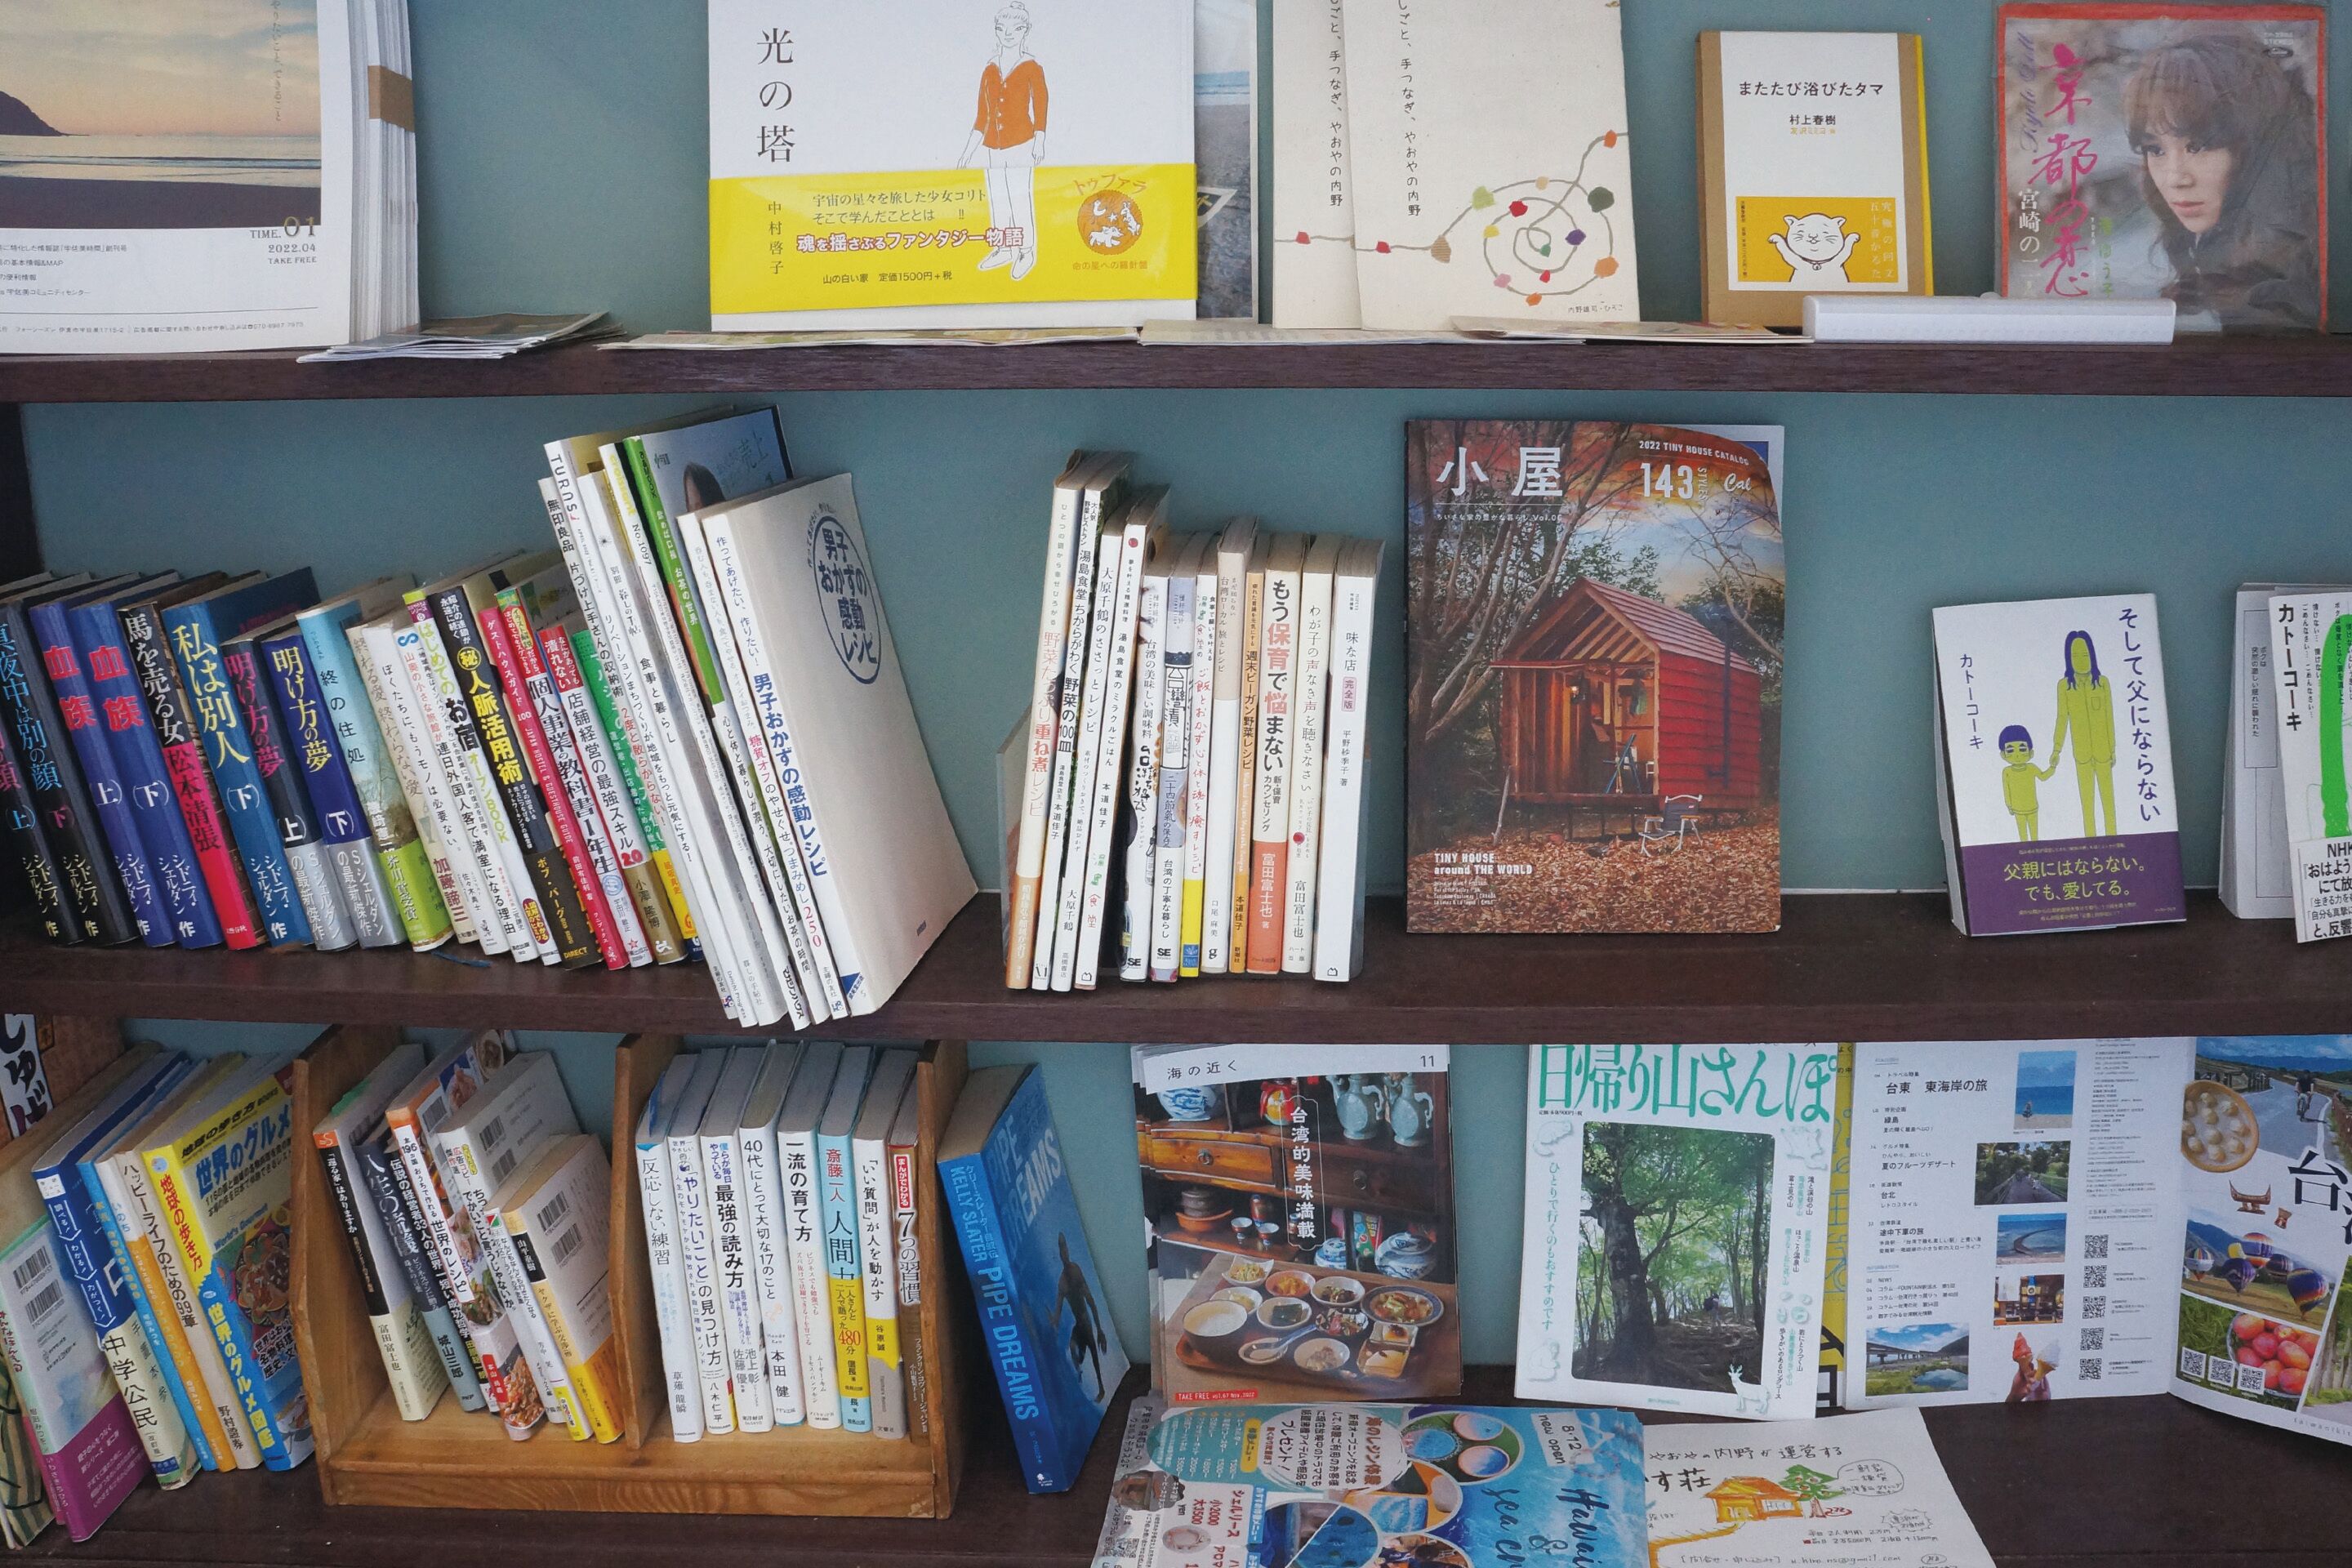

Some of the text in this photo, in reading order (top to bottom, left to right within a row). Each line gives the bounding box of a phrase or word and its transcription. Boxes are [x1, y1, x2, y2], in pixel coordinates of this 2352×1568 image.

[756, 27, 795, 163] 光の塔
[1739, 81, 1884, 97] またたび浴びたタマ
[1788, 114, 1837, 126] 村上春樹
[2028, 42, 2099, 297] 京都の恋
[813, 188, 986, 206] 宇宙の星々を旅した少女コリト
[813, 208, 935, 225] そこで学んだこととは
[268, 243, 315, 253] 2022.04
[284, 216, 315, 237] 01
[768, 200, 783, 275] 中村啓子
[796, 227, 1024, 253] 魂を揺さぶるファンタジー物語
[268, 256, 317, 265] TAKE FREE
[822, 272, 869, 284] 山の白い家
[1436, 446, 1563, 497] 小屋
[1639, 440, 1750, 466] 2022 TINY HOUSE CATALOG
[1640, 462, 1708, 501] 143 STYLES
[1080, 500, 1091, 546] 野菜レストラン
[1089, 502, 1098, 522] 大人気
[631, 523, 653, 565] No.1097
[546, 499, 575, 552] 無印良品
[569, 561, 626, 698] 片づけ上手さんの収納術
[487, 620, 532, 722] ゲストハウスガイド 100
[545, 640, 570, 689] 潰れない
[559, 636, 580, 685] なにがあっても
[1057, 550, 1092, 753] 湯島食堂 ちからがわく 野菜の100皿
[1085, 567, 1114, 733] 大原千鶴のささっとレシピ
[1263, 578, 1291, 772] もう保育で悩まない
[1343, 631, 1359, 710] 味な店 完全版
[2278, 603, 2302, 732] カトーコーキ
[42, 645, 97, 732] 血族
[88, 645, 145, 733] 血族
[124, 612, 185, 746] 馬を売る女
[172, 621, 251, 770] 私は別人
[639, 657, 677, 744] 食事と暮らし
[1104, 632, 1127, 767] 湯島食堂のミラクルごはん
[1141, 639, 1158, 739] 台湾の美味しい調味料
[1299, 605, 1321, 792] わが子の声なき声を聴きなさい
[1959, 653, 1984, 751] カトーコーキ
[225, 652, 286, 778] 明け方の夢
[274, 645, 333, 773] 明け方の夢
[319, 670, 366, 765] 終の住処
[469, 670, 523, 786] 人脈活用術
[1241, 650, 1258, 770] 週末ビーガン野菜レシピ
[2118, 608, 2161, 822] そして父にならない
[378, 706, 423, 798] 終わらない愛
[382, 664, 461, 852] ぼくたちに、もうモノは必要ない。
[567, 693, 635, 849] 店舗経営の最強スキル
[753, 672, 827, 877] 男子おかずの感動レシピ
[167, 748, 222, 853] 松本清張
[468, 752, 510, 844] オープンBOOK
[747, 733, 793, 845] 糖質オフのやせぐせ。
[1098, 782, 1111, 828] 本道佳子
[1261, 776, 1272, 832] カウンセリング
[1272, 775, 1281, 804] 新・保育
[559, 823, 573, 844] GUIDE
[1434, 853, 1494, 863] TINY HOUSE
[337, 851, 372, 938] の最新傑作
[433, 857, 469, 923] 加藤諦三
[1259, 853, 1276, 918] 富田富士也
[1434, 865, 1533, 875] around THE WORLD
[2003, 856, 2145, 881] 父親にはならない。
[2025, 880, 2130, 902] でも、愛してる。
[1063, 889, 1078, 931] 大原千鶴
[1160, 859, 1174, 938] 台湾の丁寧な暮らし
[1234, 895, 1245, 931] 本道佳子
[1293, 880, 1307, 938] 富田富士也
[45, 920, 59, 938] 作
[84, 920, 99, 938] 作
[136, 920, 150, 937] 作
[178, 920, 196, 938] 作
[270, 922, 287, 939] 作
[563, 947, 587, 960] DIRECT
[1157, 947, 1172, 957] SE
[1127, 957, 1141, 967] SE
[782, 966, 805, 1020] マガジンハウス
[1167, 1055, 1436, 1080] 海の近く 11
[1538, 1044, 1838, 1124] 日帰り山さんぽ
[1886, 1078, 1988, 1094] 台東 東海岸の旅
[195, 1104, 292, 1199] 世界のグルメ
[709, 1143, 722, 1180] やっている
[719, 1143, 733, 1184] 僕らが毎日
[826, 1147, 846, 1203] 斎藤一人
[1290, 1106, 1317, 1240] 台湾的美味満載
[1881, 1160, 1957, 1170] 夏のフルーツデザート
[641, 1156, 670, 1266] 反応しない練習
[786, 1142, 813, 1243] 一流の育て方
[950, 1165, 973, 1209] KELLY
[1881, 1191, 1896, 1200] 台北
[160, 1174, 203, 1270] 地球の歩き方
[414, 1169, 469, 1294] おうちで作れる 世界のレシピ
[715, 1183, 745, 1289] 最強の読み方
[744, 1139, 777, 1300] 40代にとって大切な17のこと
[862, 1159, 884, 1303] 「いい質問」が人を動かす
[898, 1156, 921, 1304] まんがでわかる 7つの習慣
[963, 1210, 988, 1263] SLATER
[1879, 1227, 1925, 1237] 途中下車の旅
[684, 1171, 723, 1366] 「やりたいこと」の見つけ方
[978, 1265, 1013, 1320] PIPE
[437, 1334, 464, 1379] 城山三郎
[733, 1348, 746, 1371] 佐藤
[745, 1348, 759, 1371] 池上
[838, 1330, 862, 1356] 480 分
[875, 1324, 886, 1352] 谷原誠
[104, 1334, 158, 1429] 中学公民
[207, 1303, 275, 1448] 世界のグルメ図鑑
[770, 1349, 791, 1398] 本田 健
[992, 1324, 1040, 1421] DREAMS
[1178, 1392, 1210, 1401] TAKE FREE
[710, 1382, 724, 1423] 八木仁平
[1364, 1416, 1383, 1486] 海のレジン体験
[1537, 1414, 1566, 1465] new open
[1192, 1498, 1207, 1526] 大3500
[1207, 1499, 1222, 1526] 小2000
[1227, 1489, 1245, 1539] シェルリース
